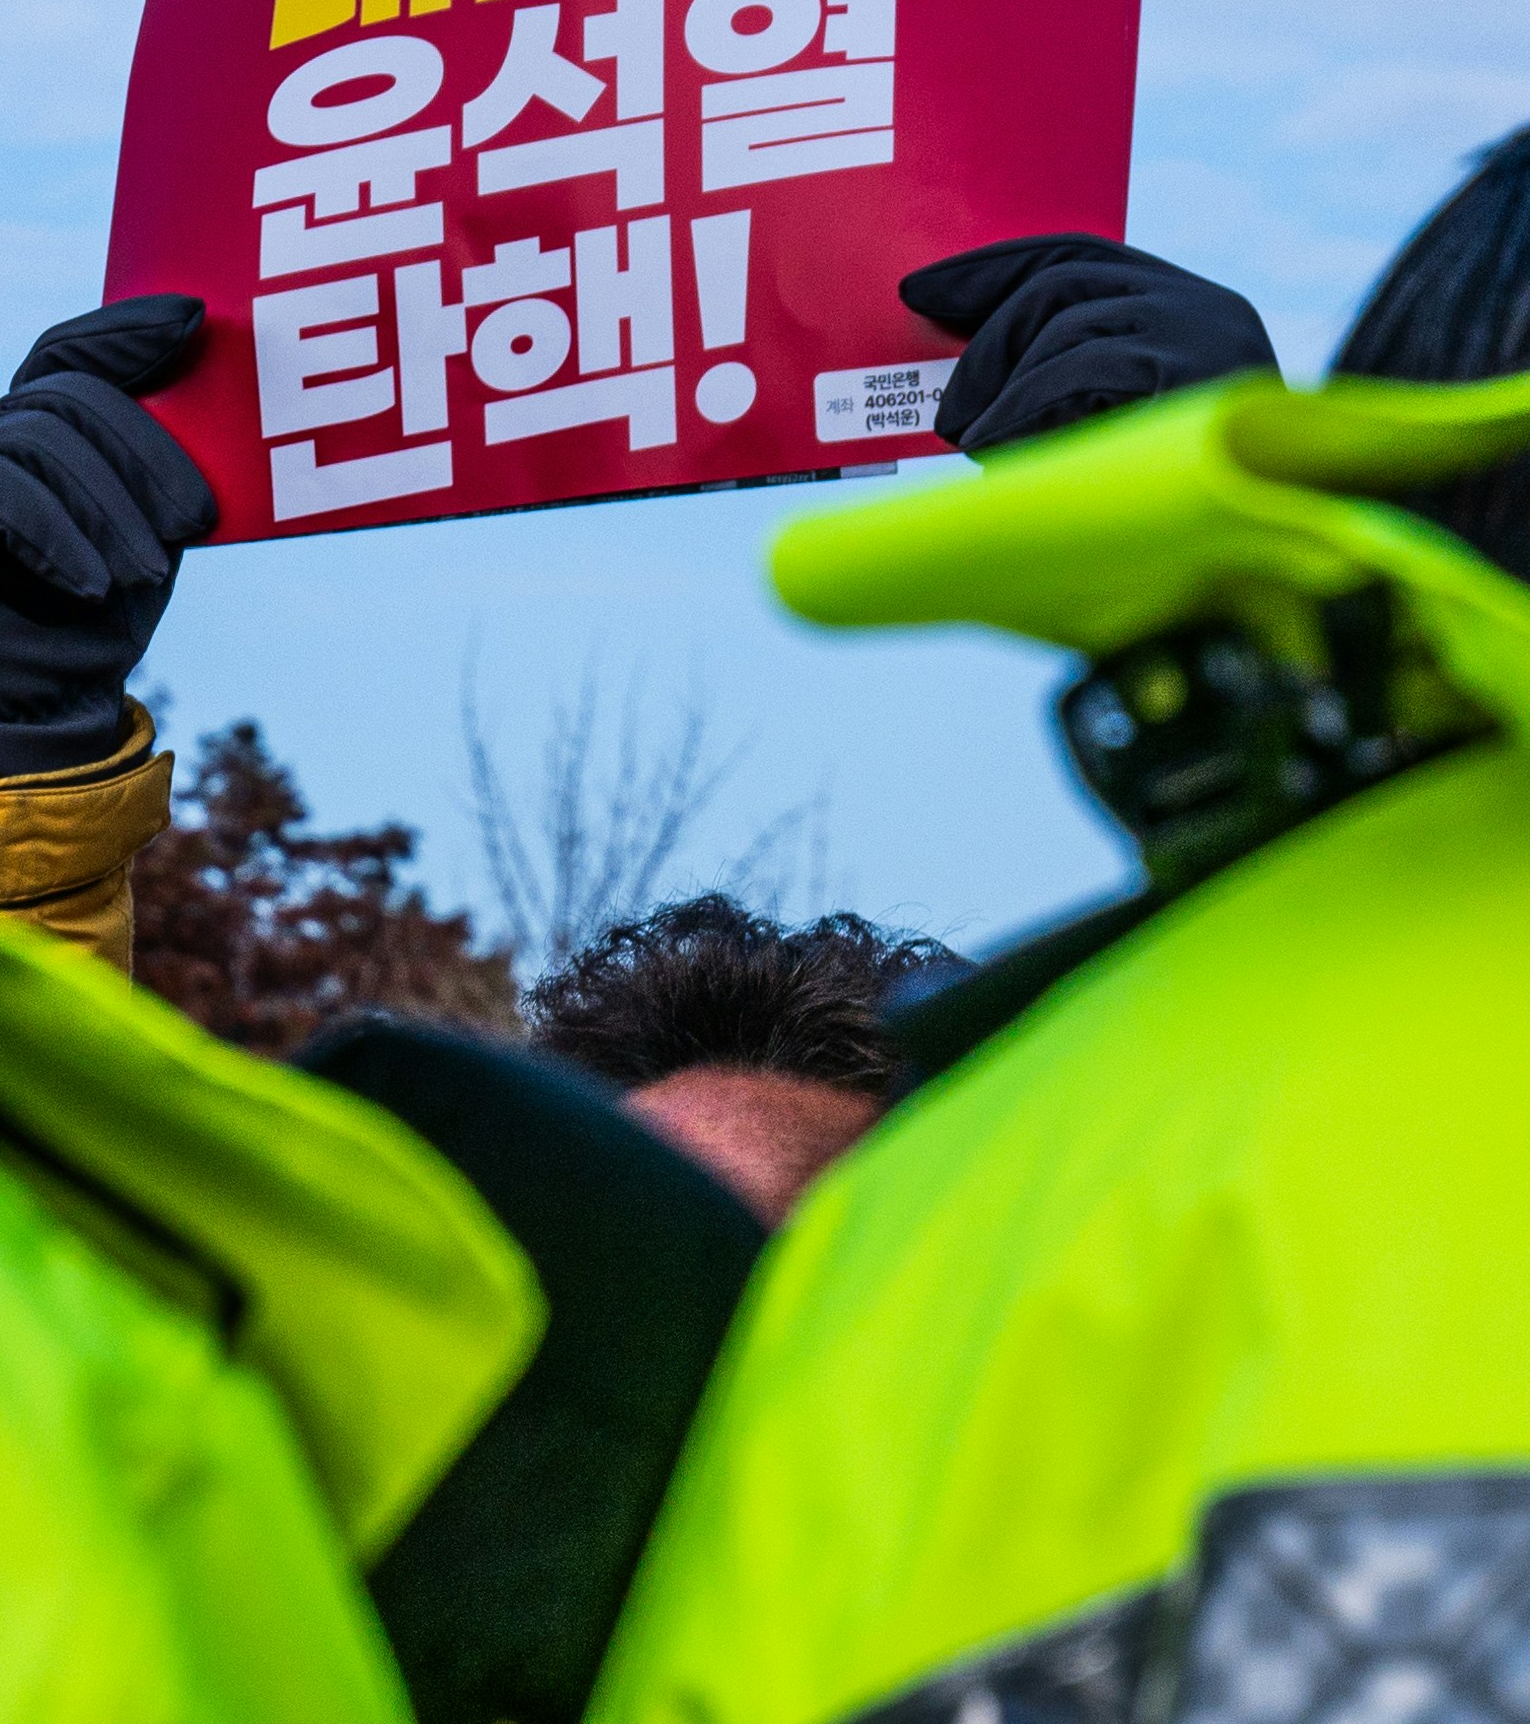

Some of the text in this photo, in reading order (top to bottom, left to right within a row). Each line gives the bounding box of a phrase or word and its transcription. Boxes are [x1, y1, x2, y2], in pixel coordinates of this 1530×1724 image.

[252, 208, 758, 523] 탄핵!
[863, 370, 920, 391] 국민은행
[826, 397, 854, 414] 계좌
[866, 408, 920, 431] (박석운)
